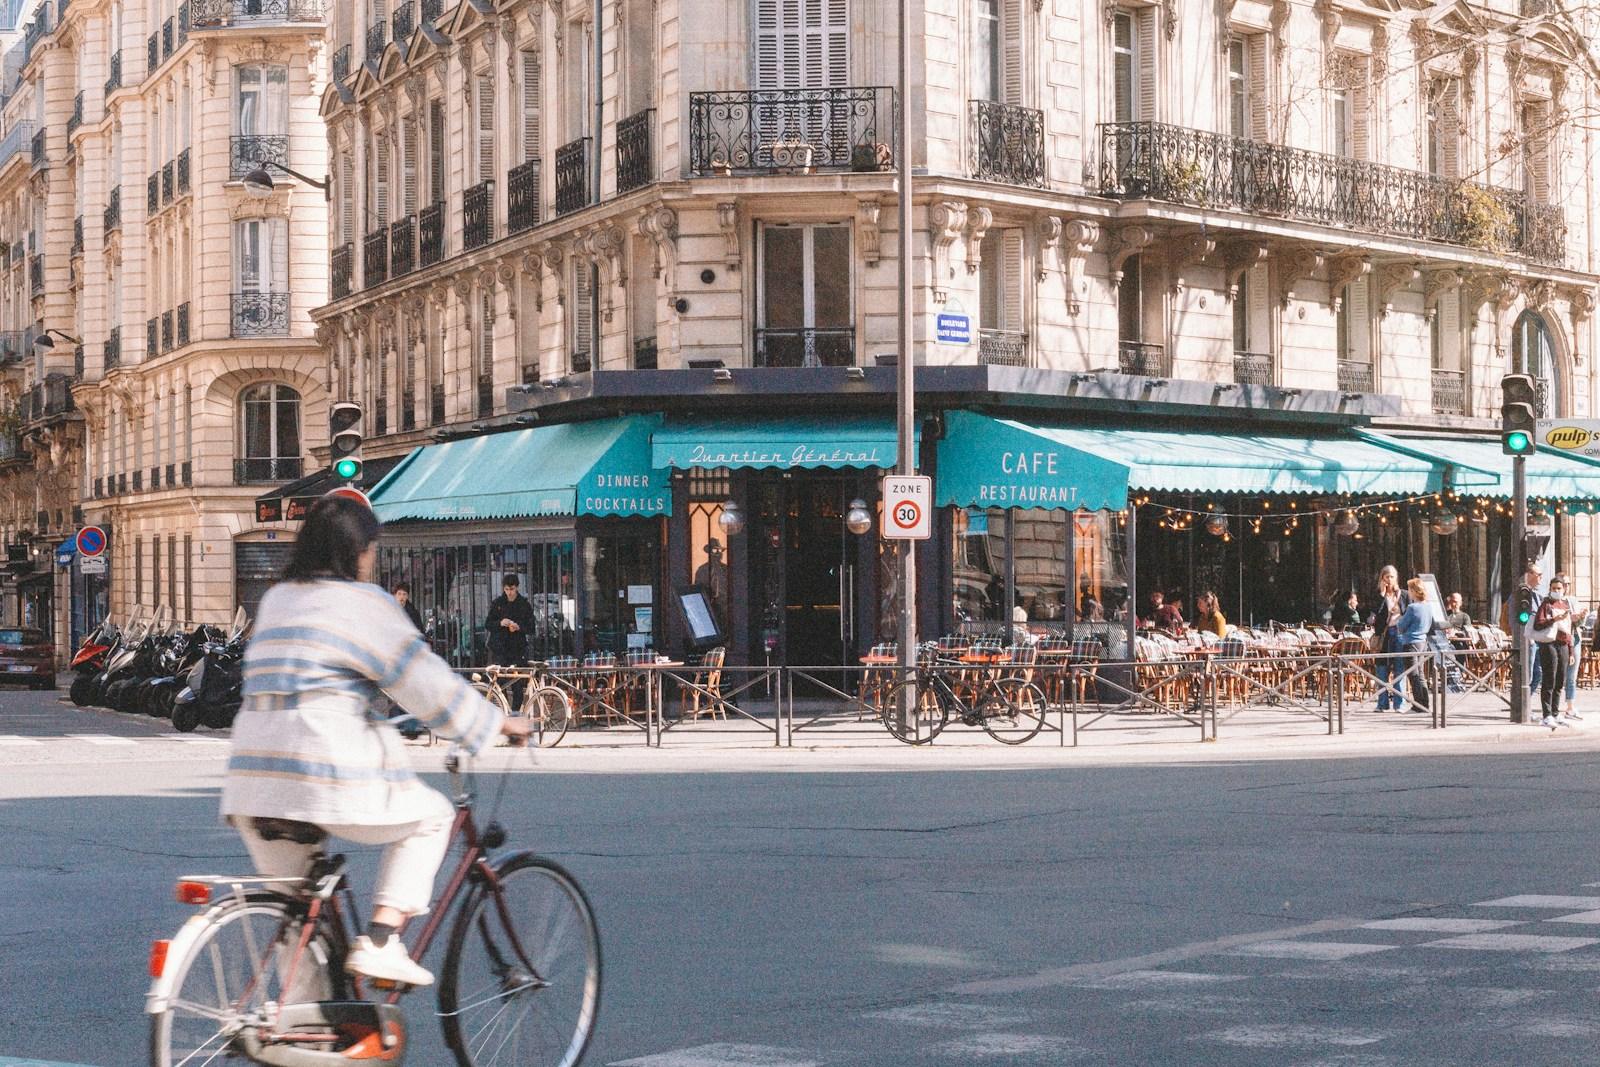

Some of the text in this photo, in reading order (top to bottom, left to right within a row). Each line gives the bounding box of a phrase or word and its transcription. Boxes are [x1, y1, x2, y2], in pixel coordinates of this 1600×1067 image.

[689, 444, 881, 466] Quartier Général
[1002, 452, 1058, 474] CAFE
[598, 474, 649, 488] DINNER
[893, 485, 921, 493] ZONE
[980, 485, 1078, 502] RESTAURANT
[586, 497, 664, 511] COCKTAILS
[899, 508, 916, 521] 30
